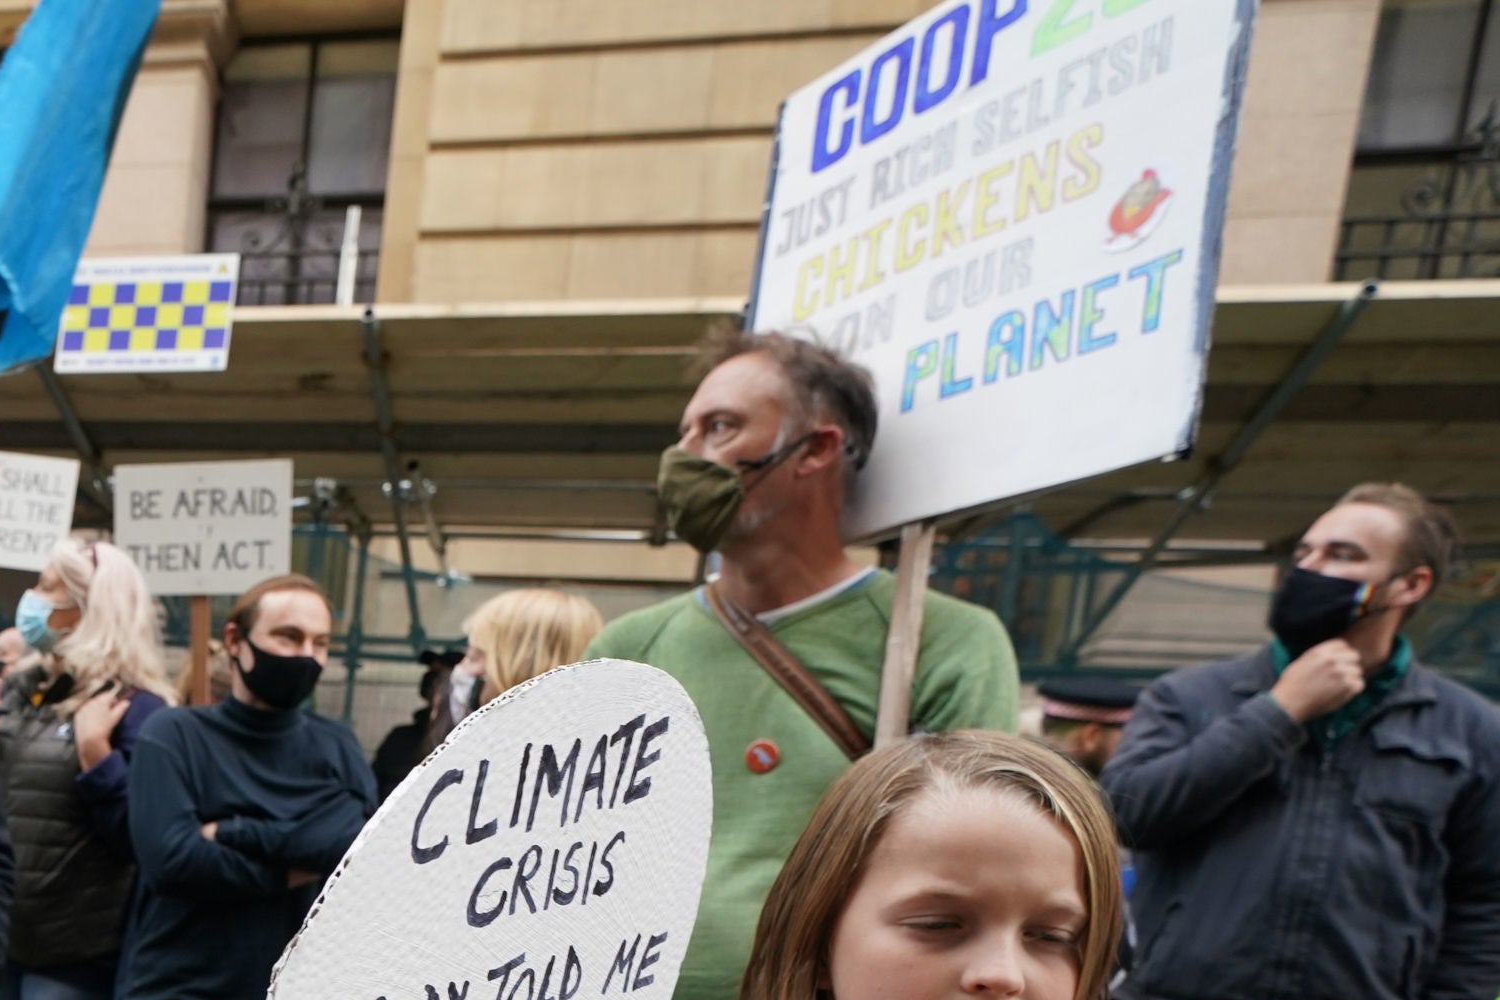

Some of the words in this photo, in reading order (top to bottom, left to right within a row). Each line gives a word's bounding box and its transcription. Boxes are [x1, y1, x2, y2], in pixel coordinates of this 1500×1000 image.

[776, 176, 856, 258] JUST
[870, 120, 957, 210] RICH
[972, 16, 1175, 158] SELFISH
[792, 122, 1104, 322] CHICKENS
[925, 237, 1034, 323] OUR
[899, 248, 1184, 414] PLANET
[25, 498, 65, 525] THE
[130, 489, 162, 521] BE
[127, 543, 200, 573] THEN
[212, 538, 275, 572] ACT.
[410, 713, 670, 865] CLIMATE
[466, 831, 626, 928] CRISIS
[601, 932, 668, 996] ME
